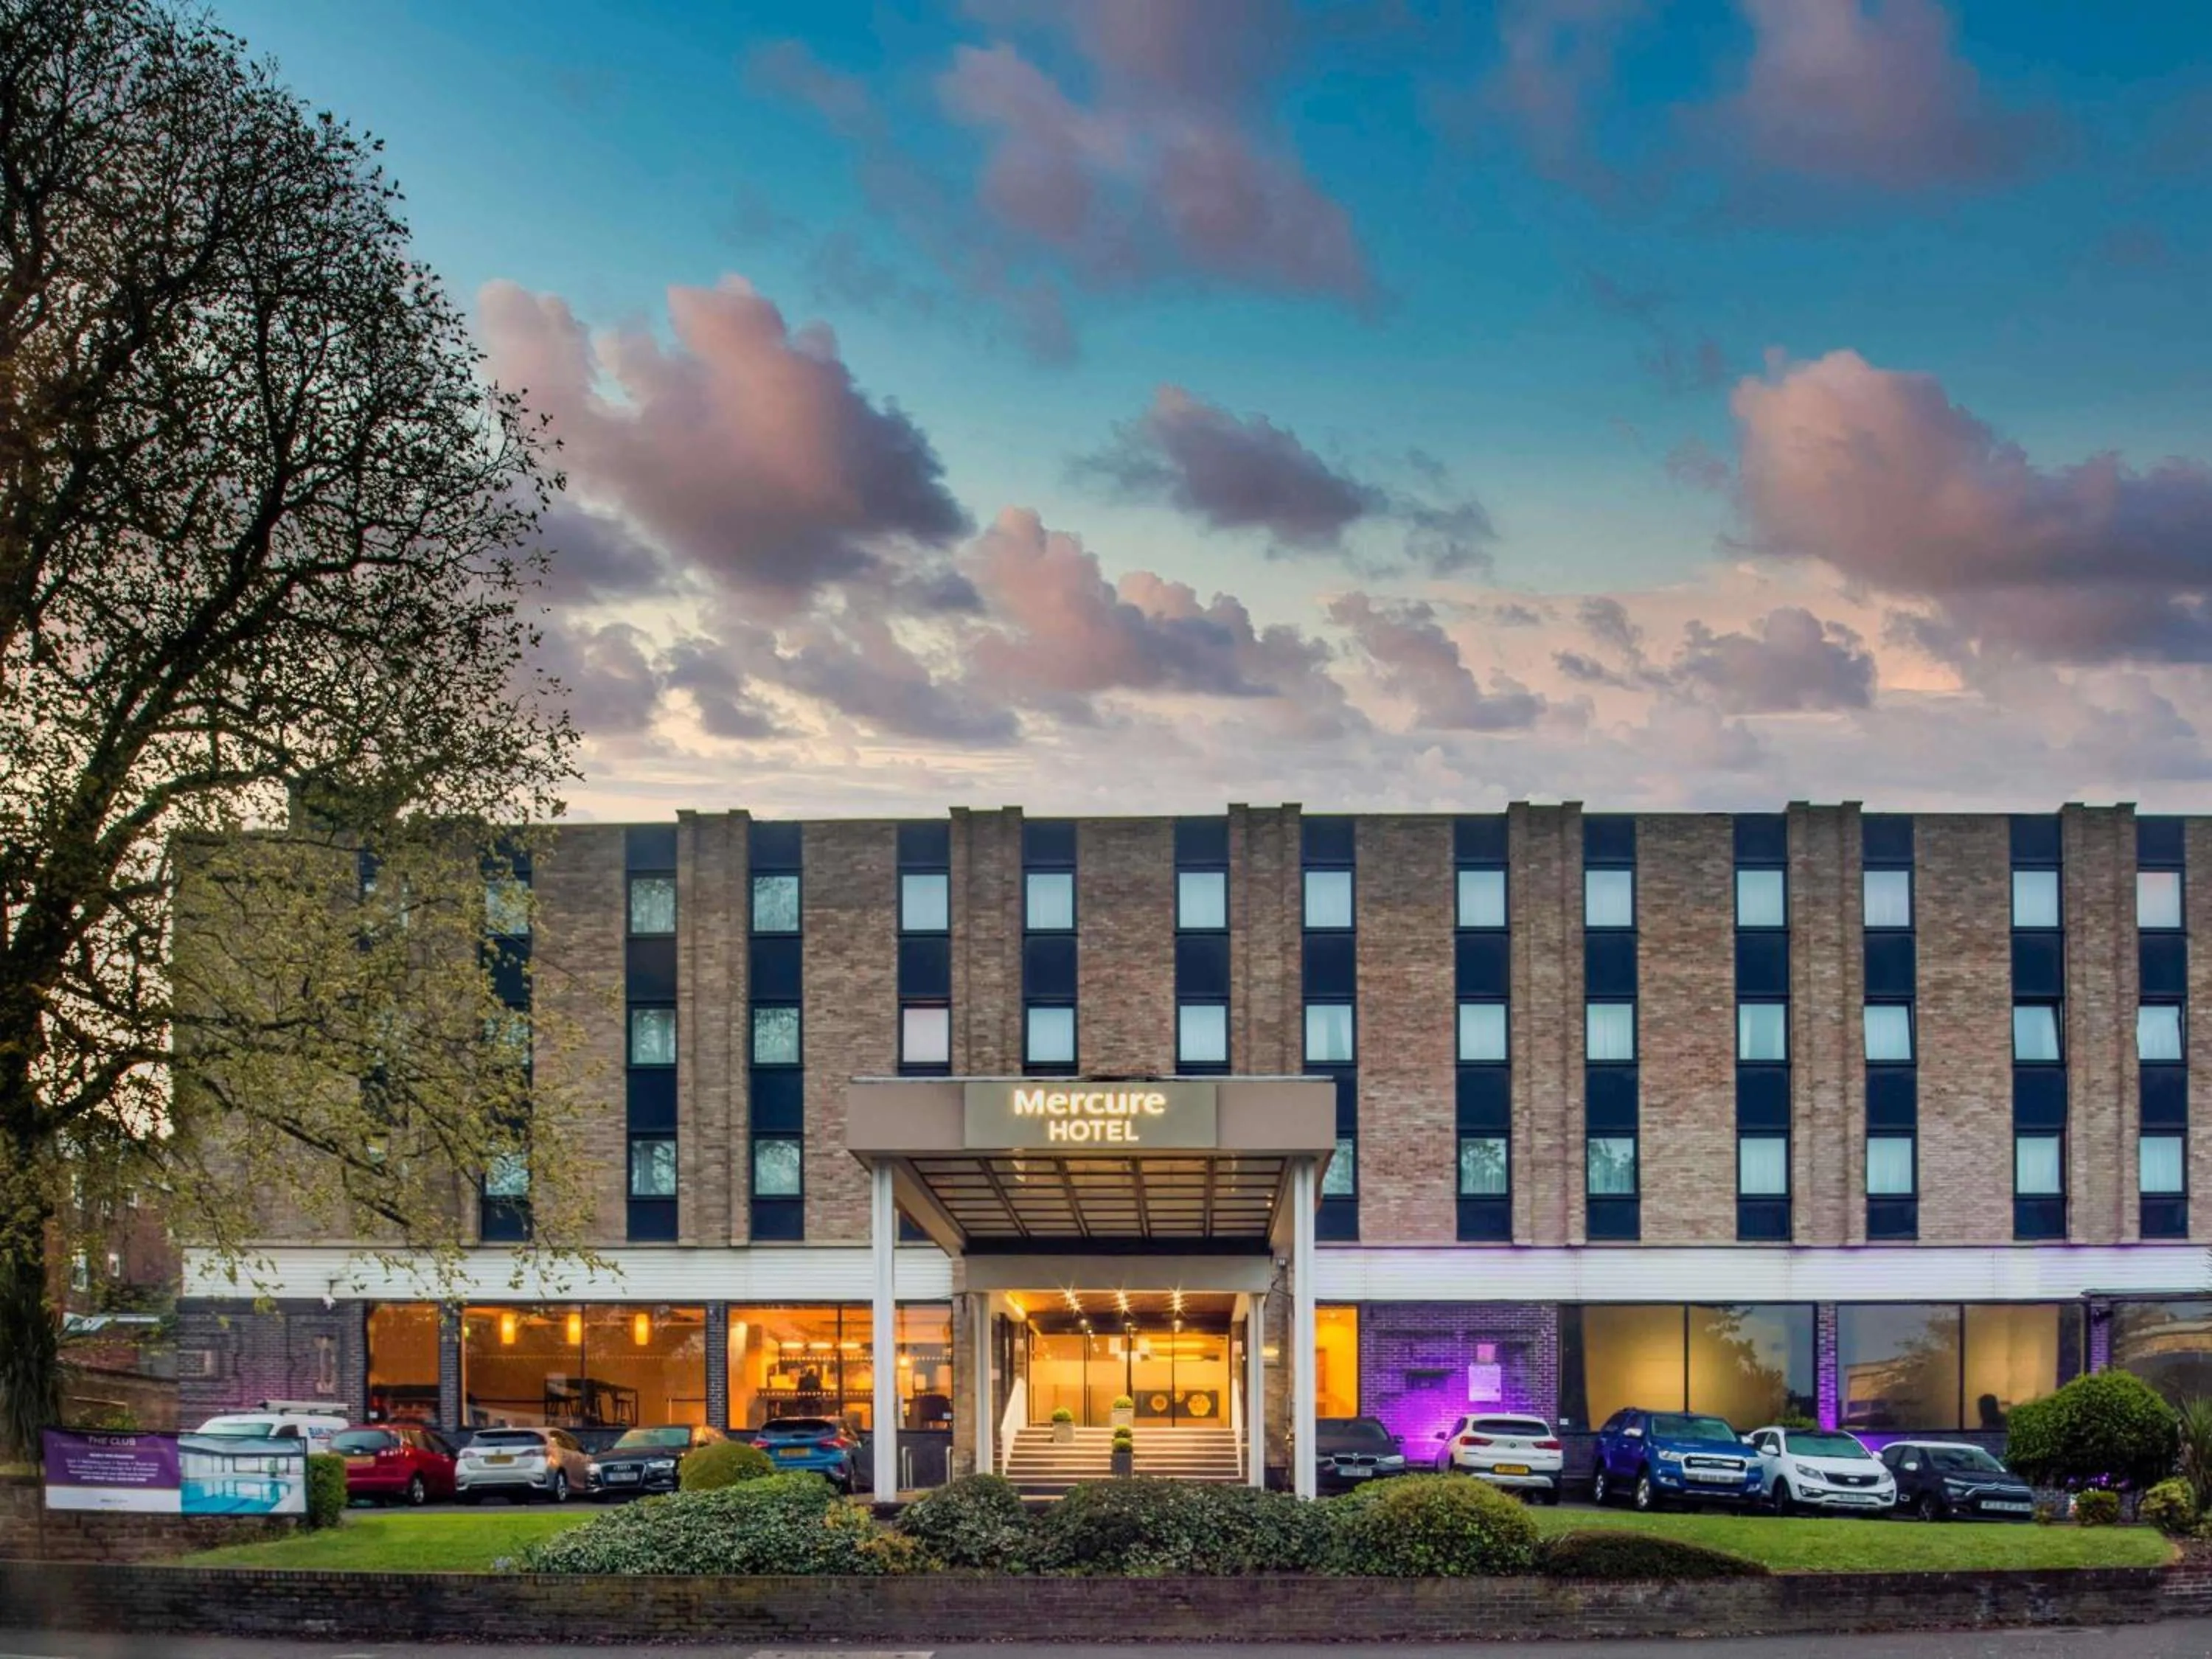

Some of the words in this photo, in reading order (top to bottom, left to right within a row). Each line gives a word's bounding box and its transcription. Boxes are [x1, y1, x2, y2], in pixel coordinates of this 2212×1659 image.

[1014, 1089, 1166, 1116] Mercure
[1048, 1119, 1140, 1142] HOTEL
[88, 1436, 108, 1445] THE
[110, 1437, 136, 1447] CLUB
